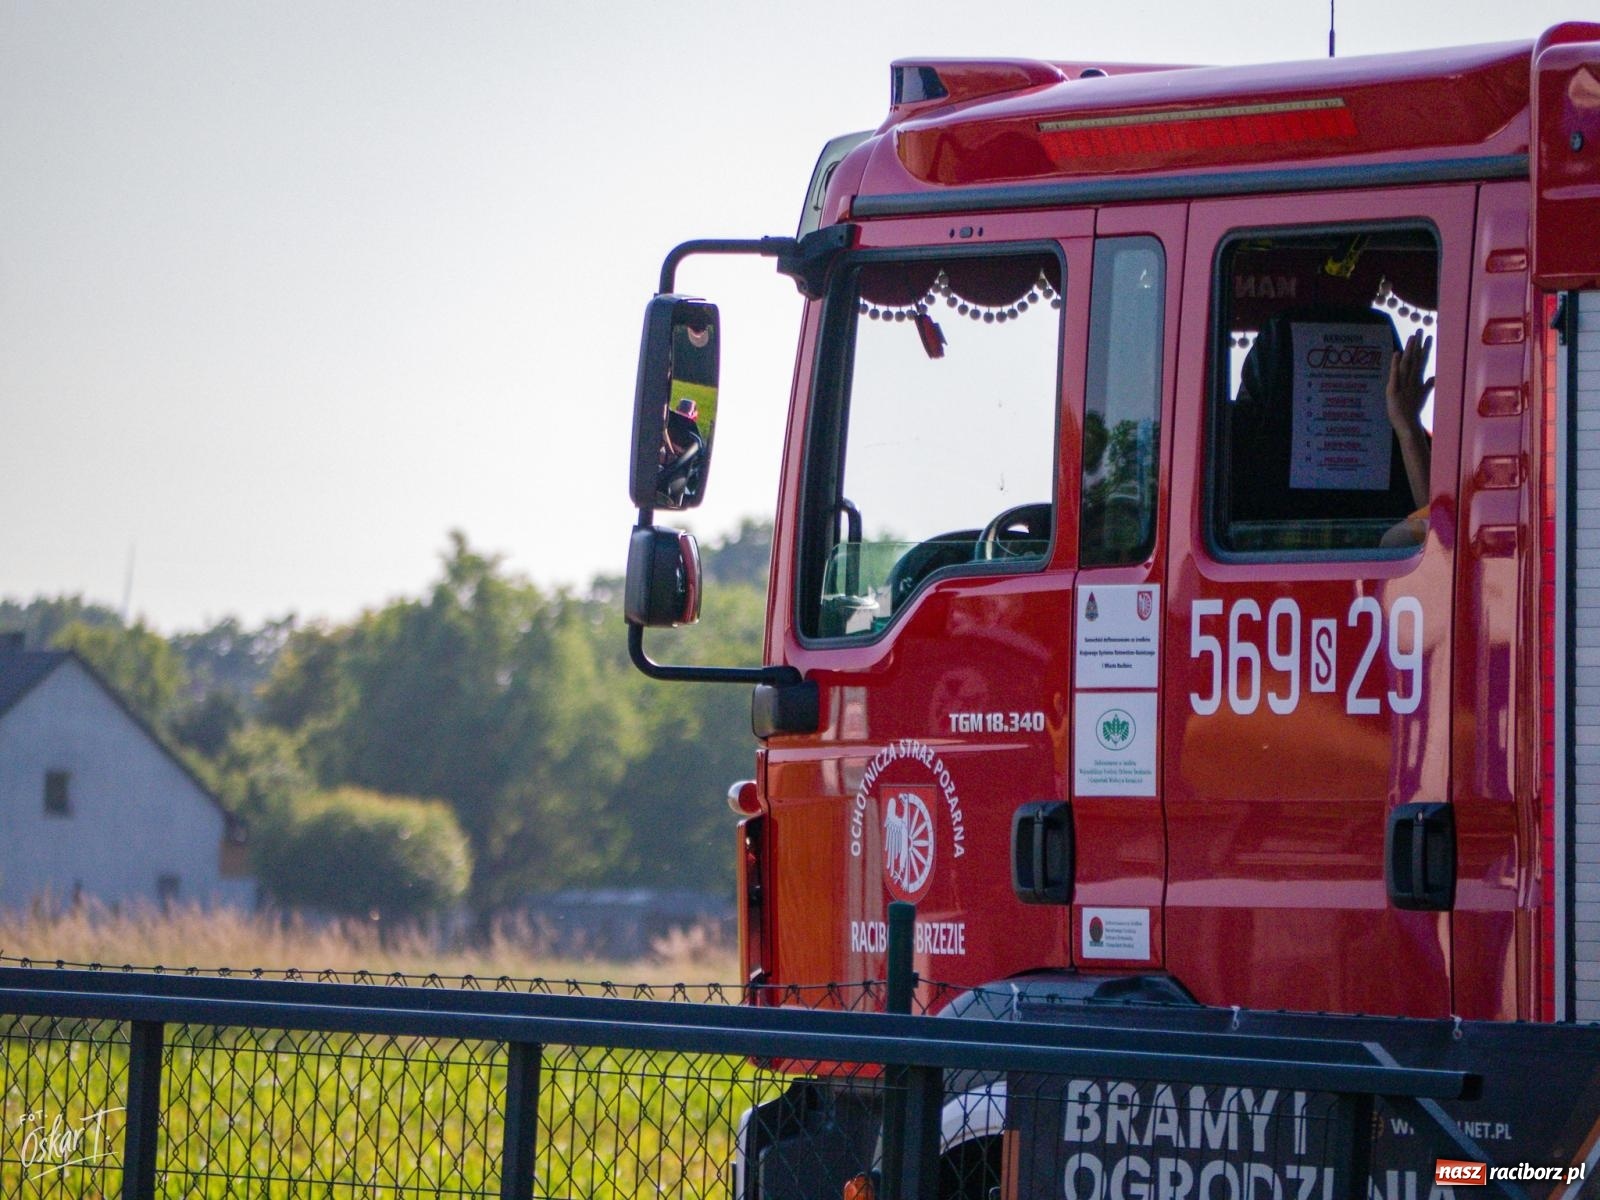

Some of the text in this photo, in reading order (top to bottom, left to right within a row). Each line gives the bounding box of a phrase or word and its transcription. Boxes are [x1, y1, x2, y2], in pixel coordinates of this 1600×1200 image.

[948, 711, 1045, 733] TGM 18.340
[851, 743, 897, 857] OCHOTNICZA
[851, 920, 890, 953] RACIB
[1063, 1078, 1280, 1153] BRAMY
